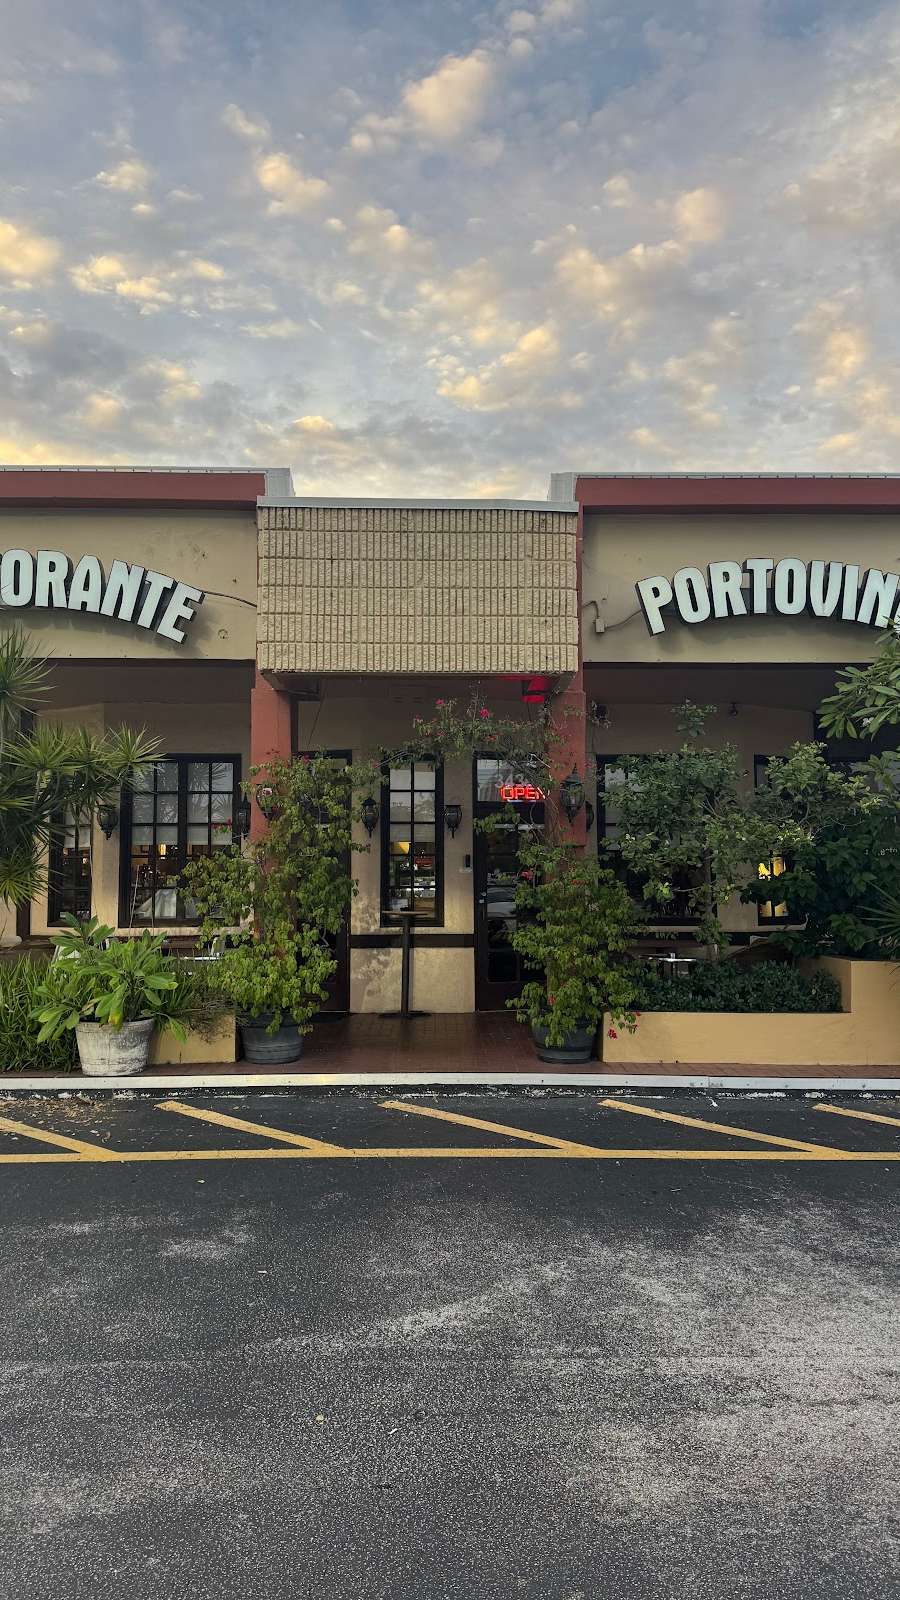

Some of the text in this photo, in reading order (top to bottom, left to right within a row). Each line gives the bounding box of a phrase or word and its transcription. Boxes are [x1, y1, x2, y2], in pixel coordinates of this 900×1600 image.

[0, 549, 204, 643] ORANTE
[636, 558, 900, 636] PORTOVIN
[502, 786, 546, 799] OPEN
